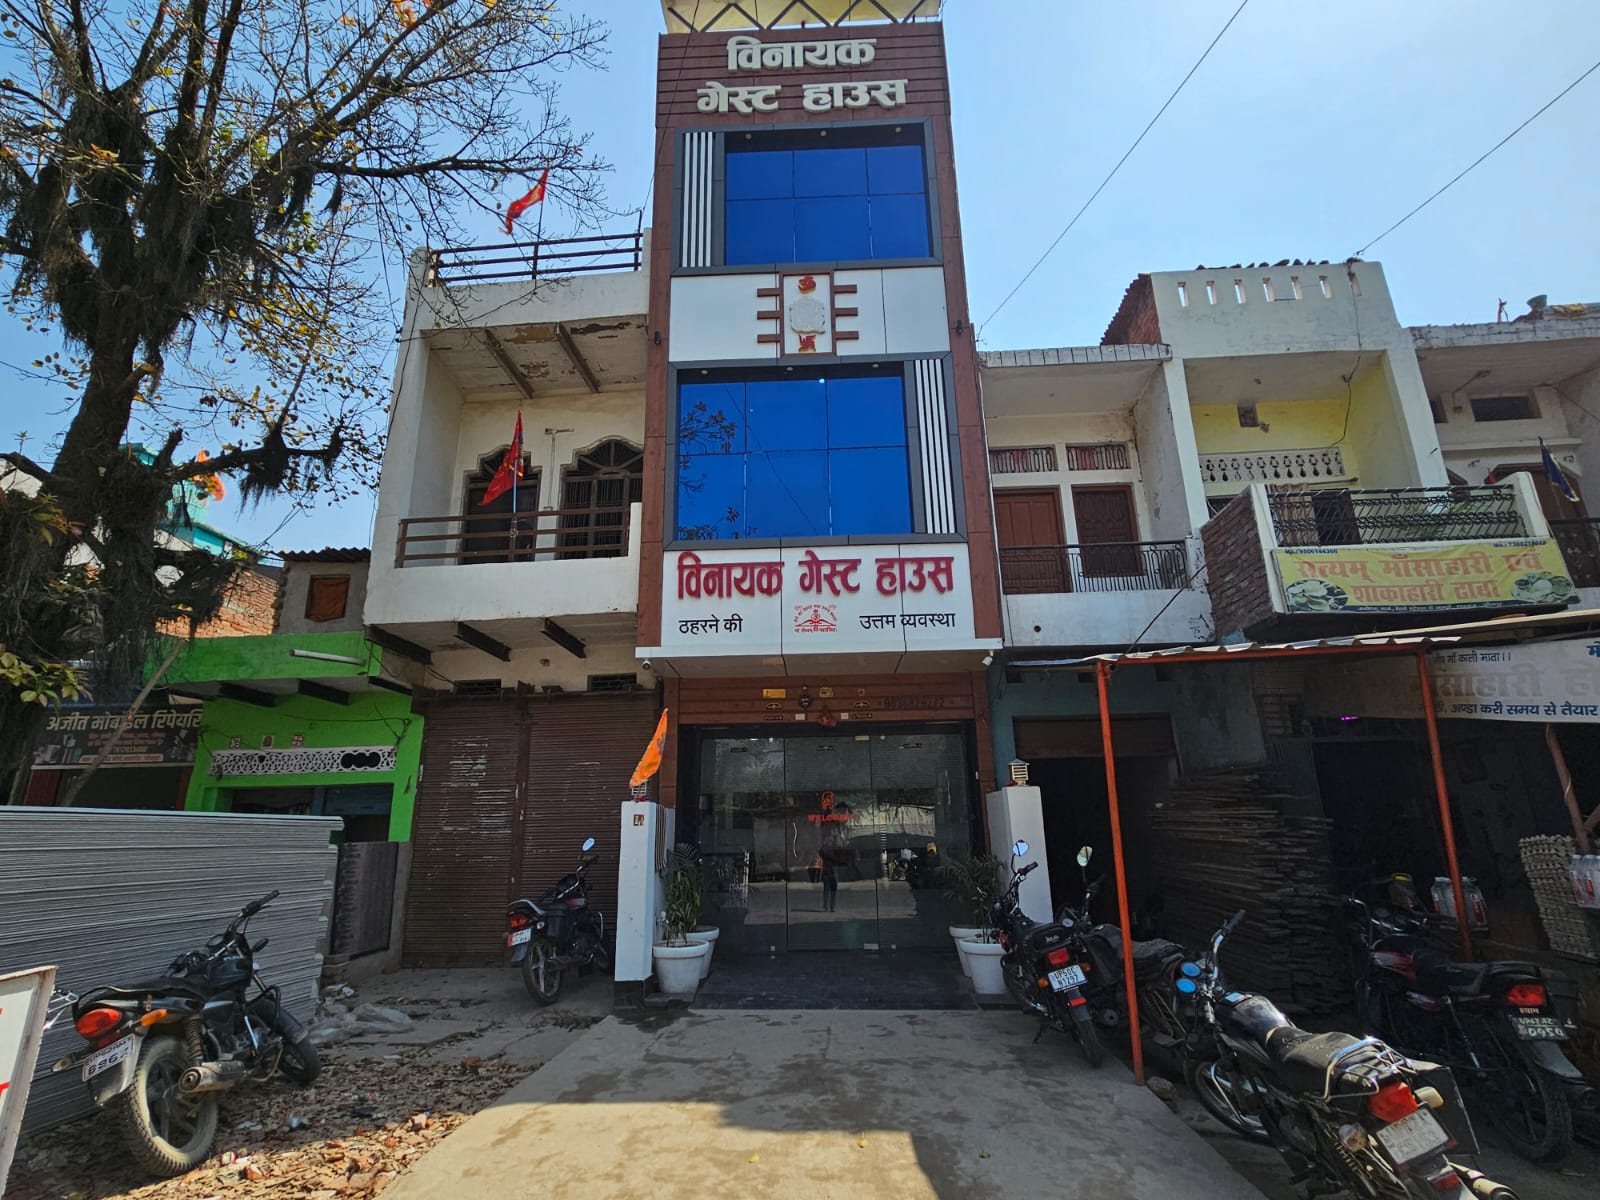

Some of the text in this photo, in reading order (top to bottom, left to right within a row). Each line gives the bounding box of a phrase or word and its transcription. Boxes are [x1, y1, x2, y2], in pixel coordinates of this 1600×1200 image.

[726, 35, 877, 71] विनायक
[696, 79, 908, 115] गेस्ट हाउस
[677, 550, 954, 600] विनायक गेस्ट हाउस
[1351, 579, 1445, 602] शाकाहारी
[678, 612, 956, 634] ठहरने की उत्तम व्यवस्था
[1480, 701, 1503, 715] करी
[1506, 705, 1540, 716] समय
[1543, 702, 1557, 716] से
[1560, 701, 1598, 716] तैयार
[46, 712, 91, 731] अजीत
[91, 711, 148, 730] मोबल
